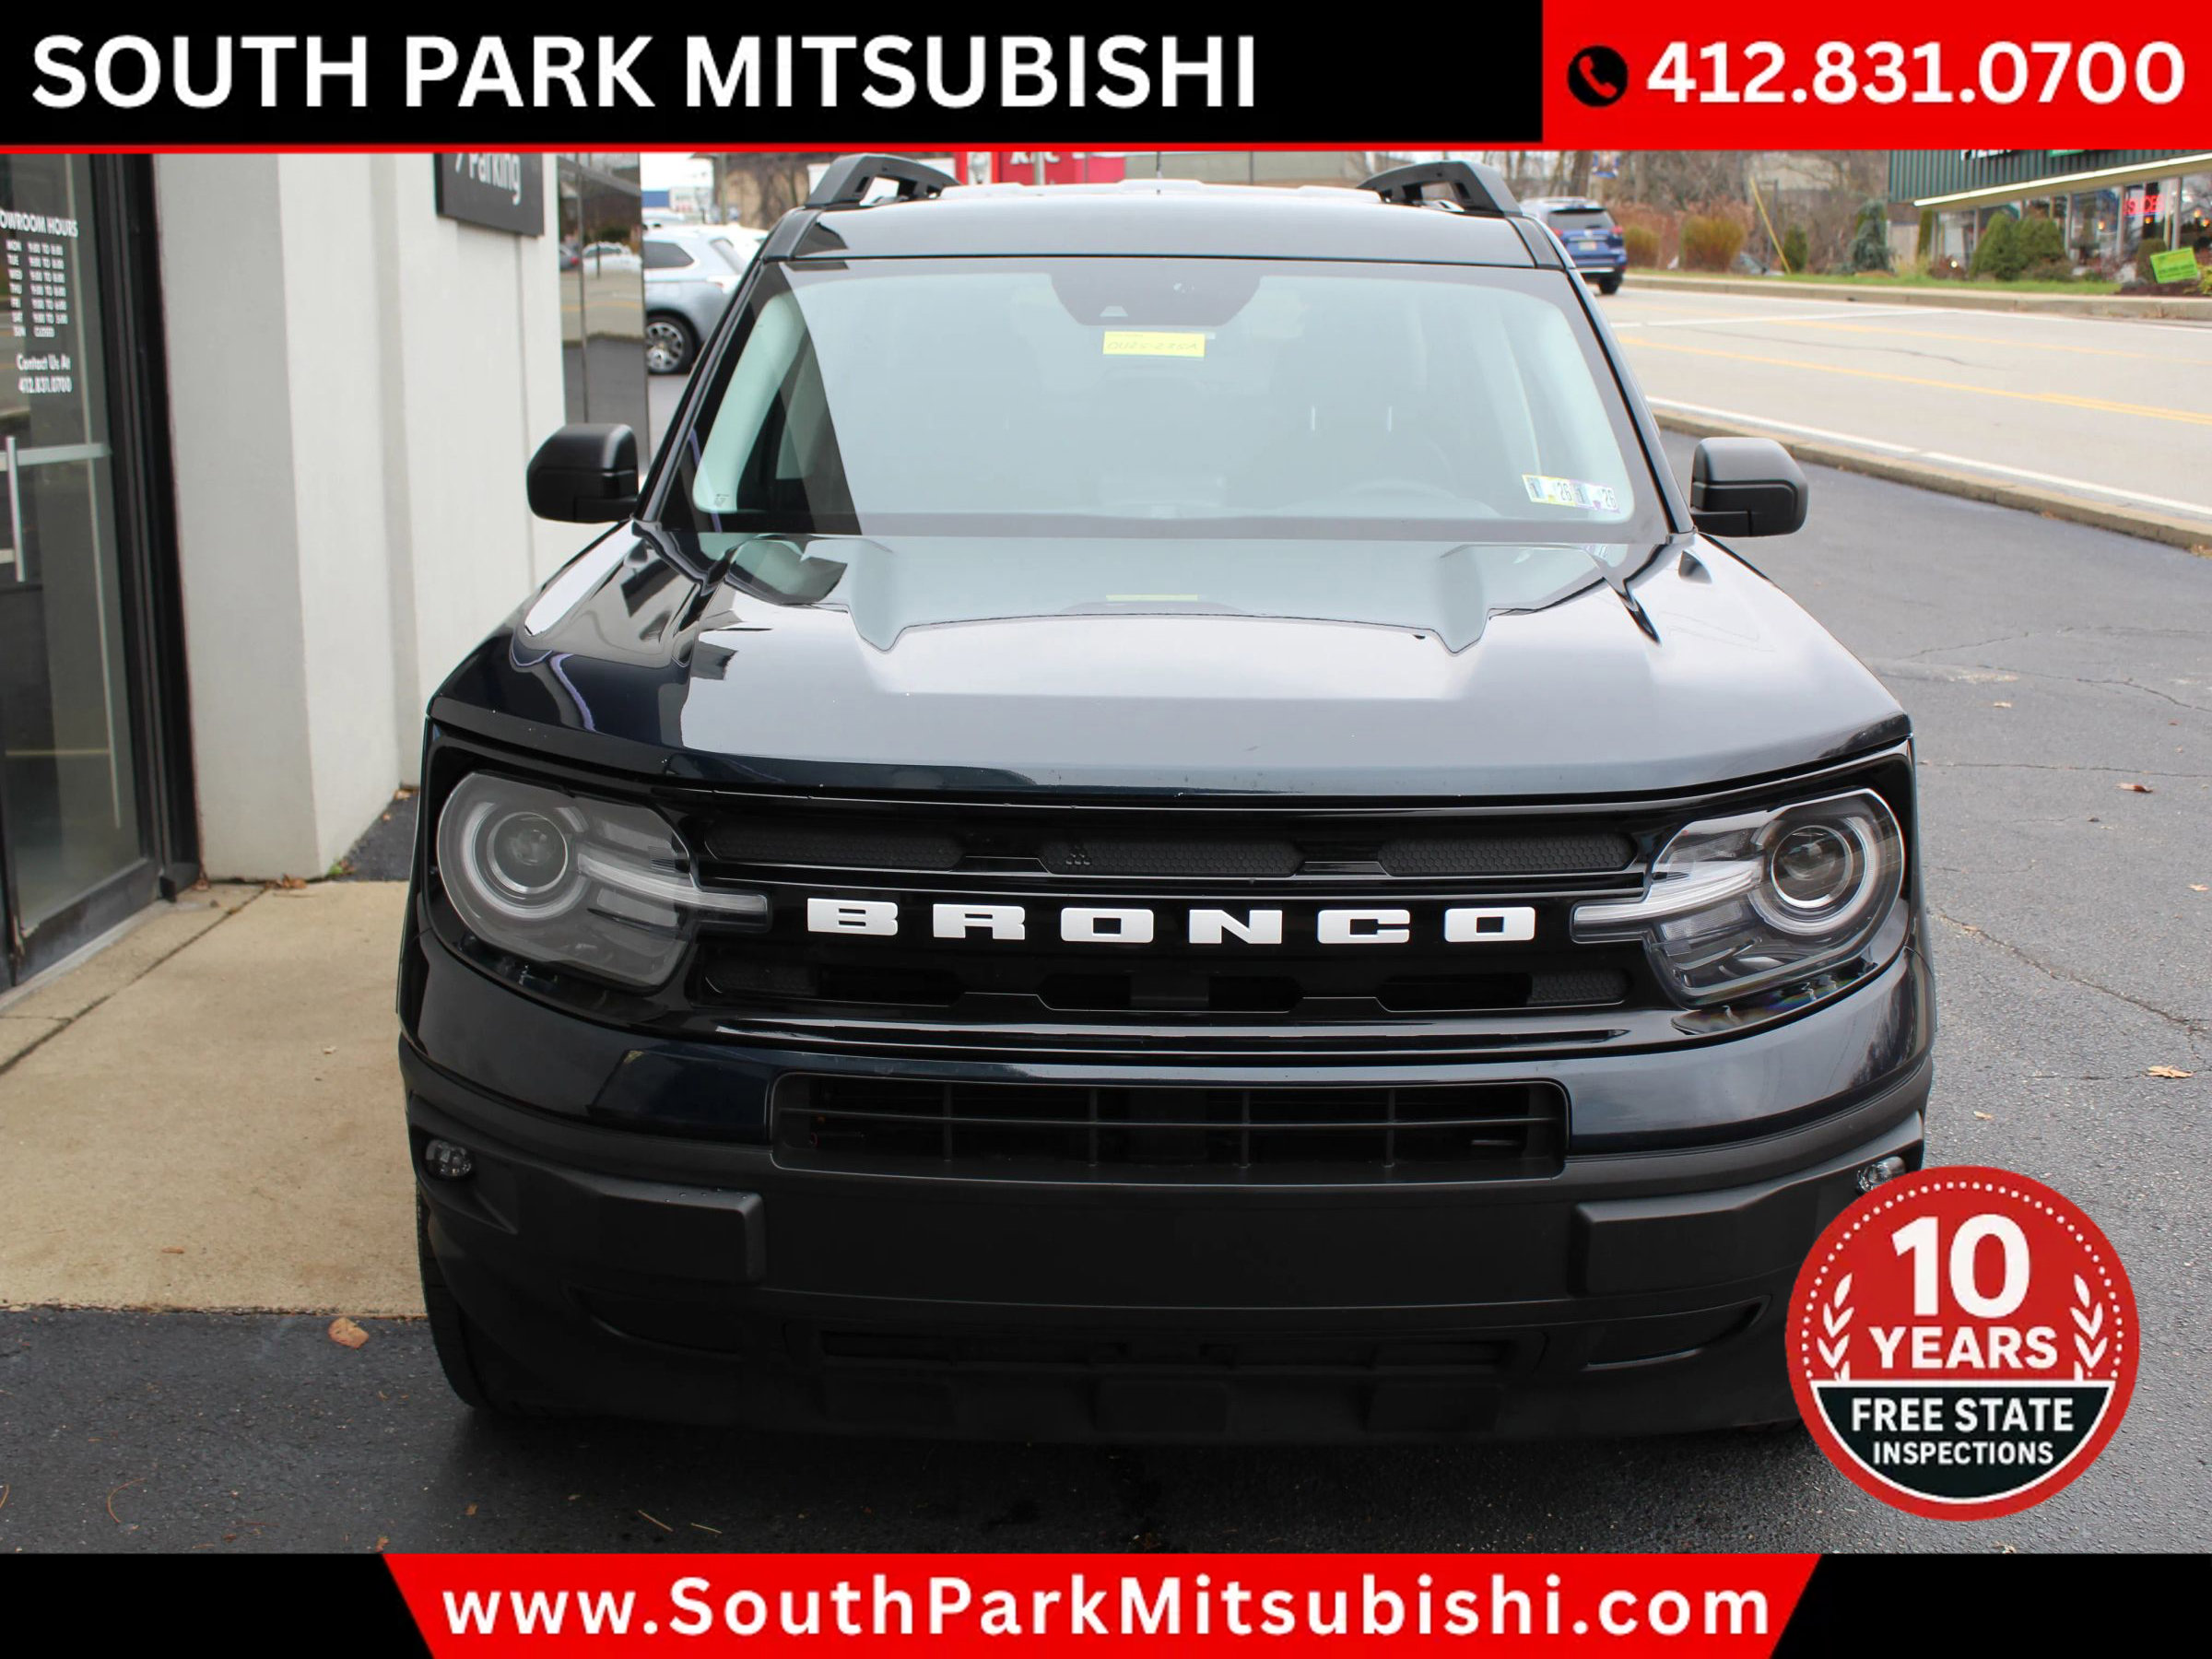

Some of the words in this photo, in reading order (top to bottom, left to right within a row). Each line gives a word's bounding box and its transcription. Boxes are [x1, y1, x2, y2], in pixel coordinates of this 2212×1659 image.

[46, 216, 79, 238] HOURS
[16, 353, 48, 371] Contact
[48, 353, 60, 371] Us
[806, 897, 1535, 945] BRONCO
